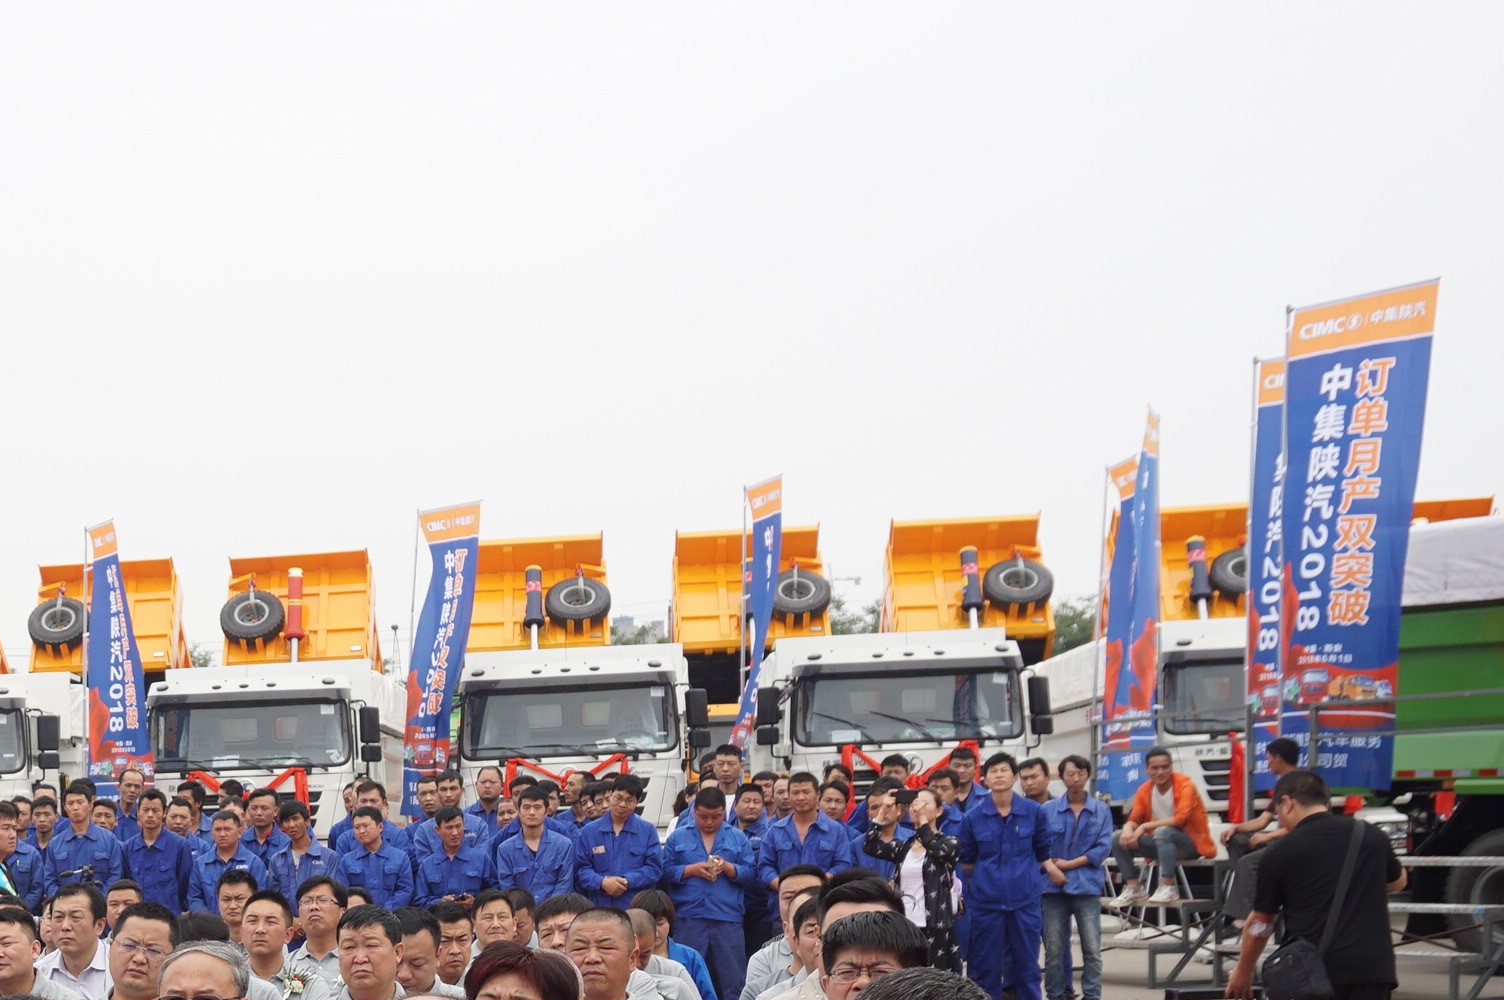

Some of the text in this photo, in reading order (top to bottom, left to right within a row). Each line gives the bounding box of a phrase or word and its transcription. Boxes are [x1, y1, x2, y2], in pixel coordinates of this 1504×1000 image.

[1299, 301, 1427, 341] CIMC 中集陕汽
[1297, 363, 1354, 632] 中集陕汽2018
[1328, 357, 1396, 627] 订单月产双突破
